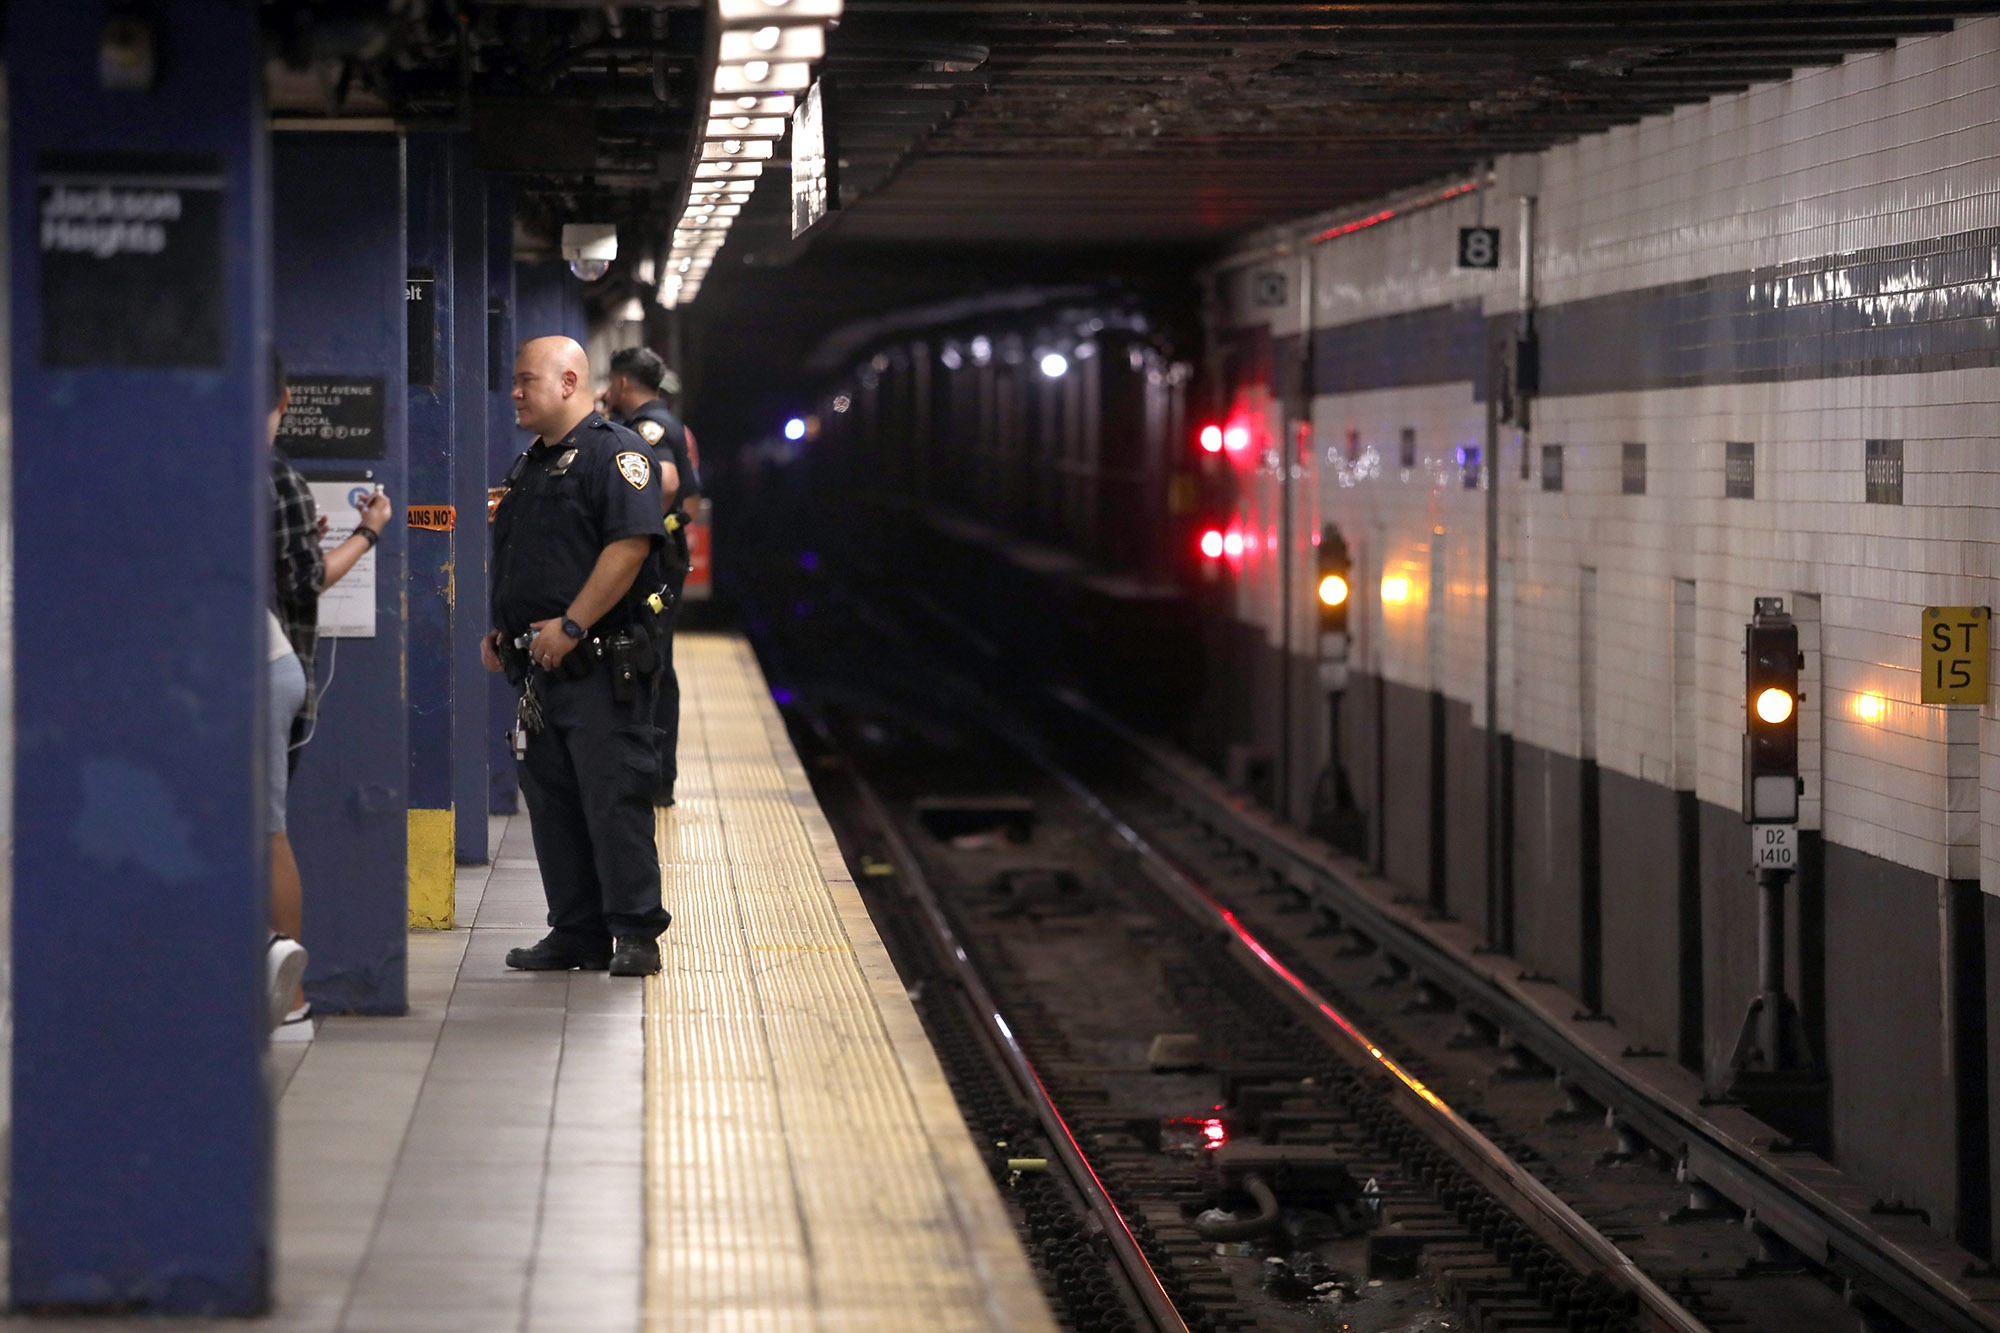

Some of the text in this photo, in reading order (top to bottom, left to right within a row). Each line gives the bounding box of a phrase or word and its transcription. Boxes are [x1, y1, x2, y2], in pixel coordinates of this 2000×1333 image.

[43, 185, 182, 221] Jackson
[42, 221, 166, 259] Heights
[1466, 230, 1493, 266] 8
[331, 386, 373, 395] AVENUE
[311, 396, 341, 405] HILLS
[297, 417, 332, 426] LOCAL
[291, 427, 317, 436] PLAT
[350, 428, 371, 436] EXP
[1931, 623, 1979, 652] ST
[1937, 660, 1971, 688] 15
[1766, 830, 1785, 844] D2
[1760, 848, 1791, 863] 1410
